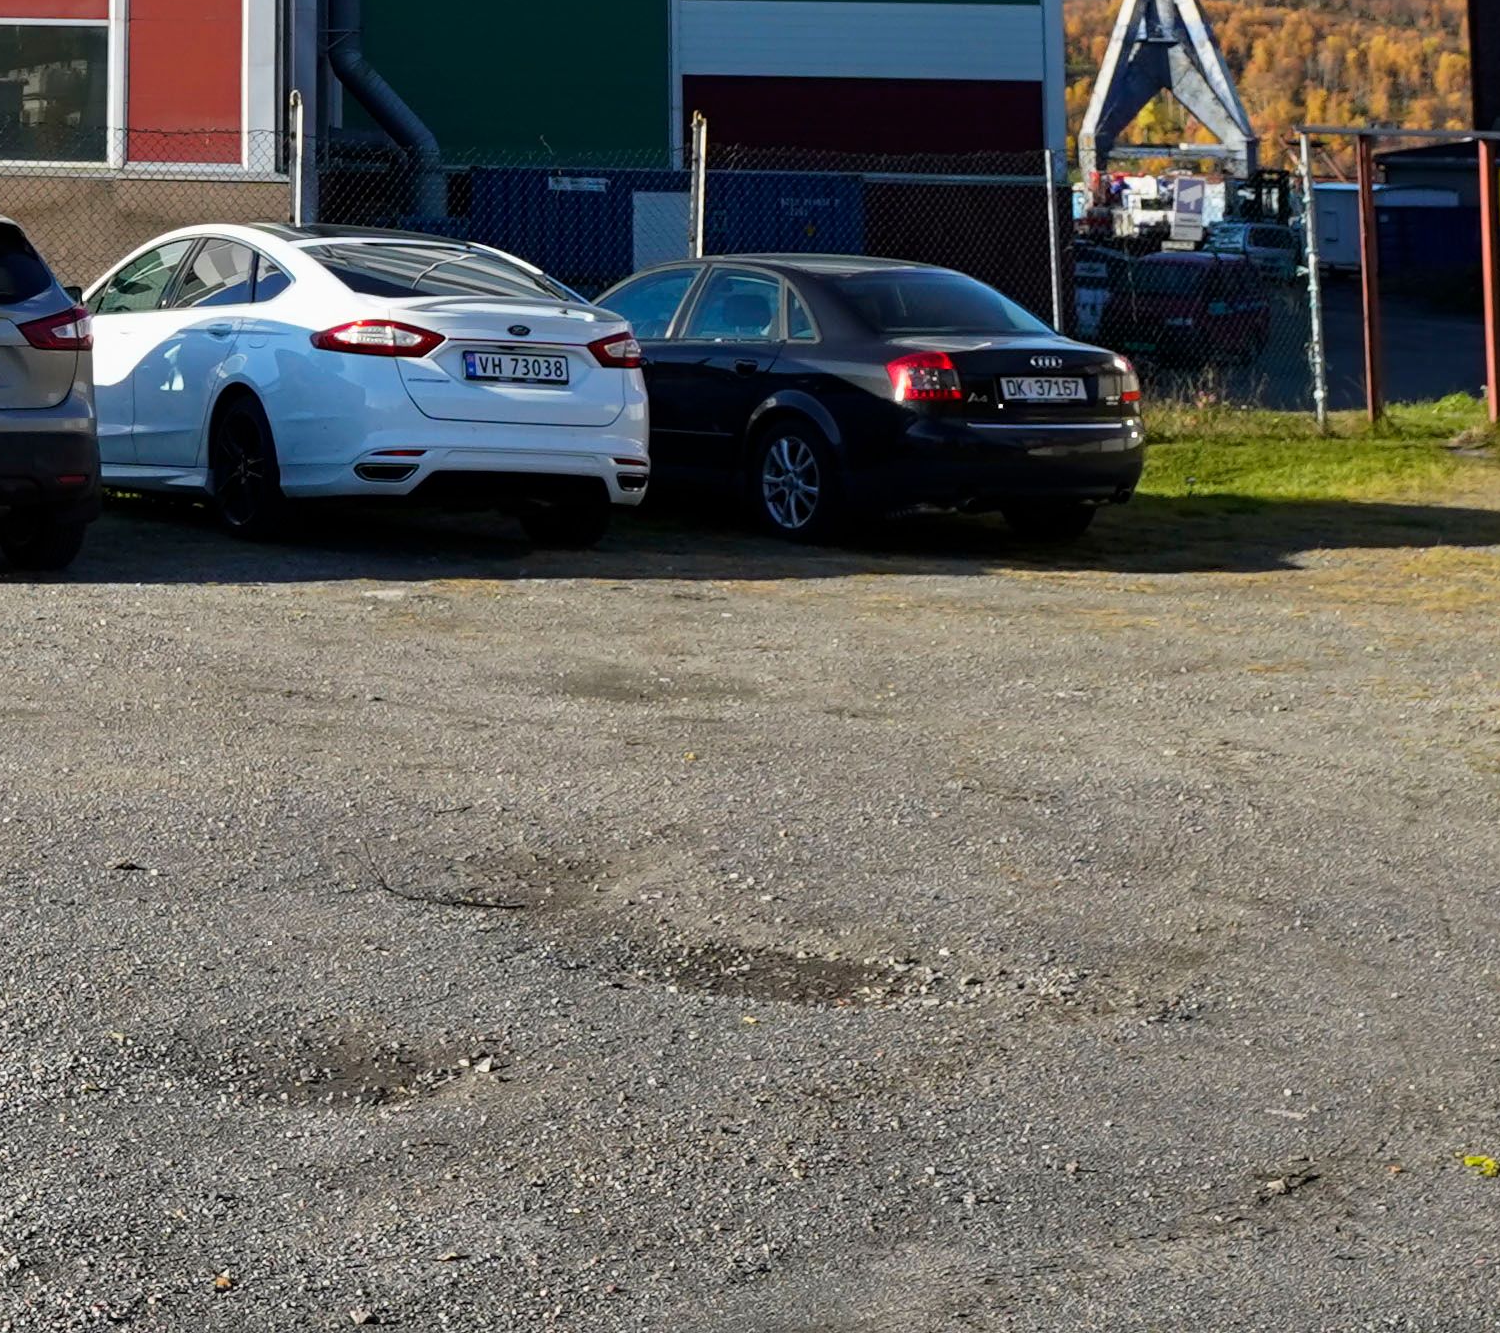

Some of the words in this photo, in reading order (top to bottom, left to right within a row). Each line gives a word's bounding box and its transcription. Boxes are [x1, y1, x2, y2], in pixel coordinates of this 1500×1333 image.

[478, 356, 503, 374] VH
[510, 358, 564, 377] 73038
[1006, 379, 1027, 397] DK
[1036, 379, 1079, 397] 37167
